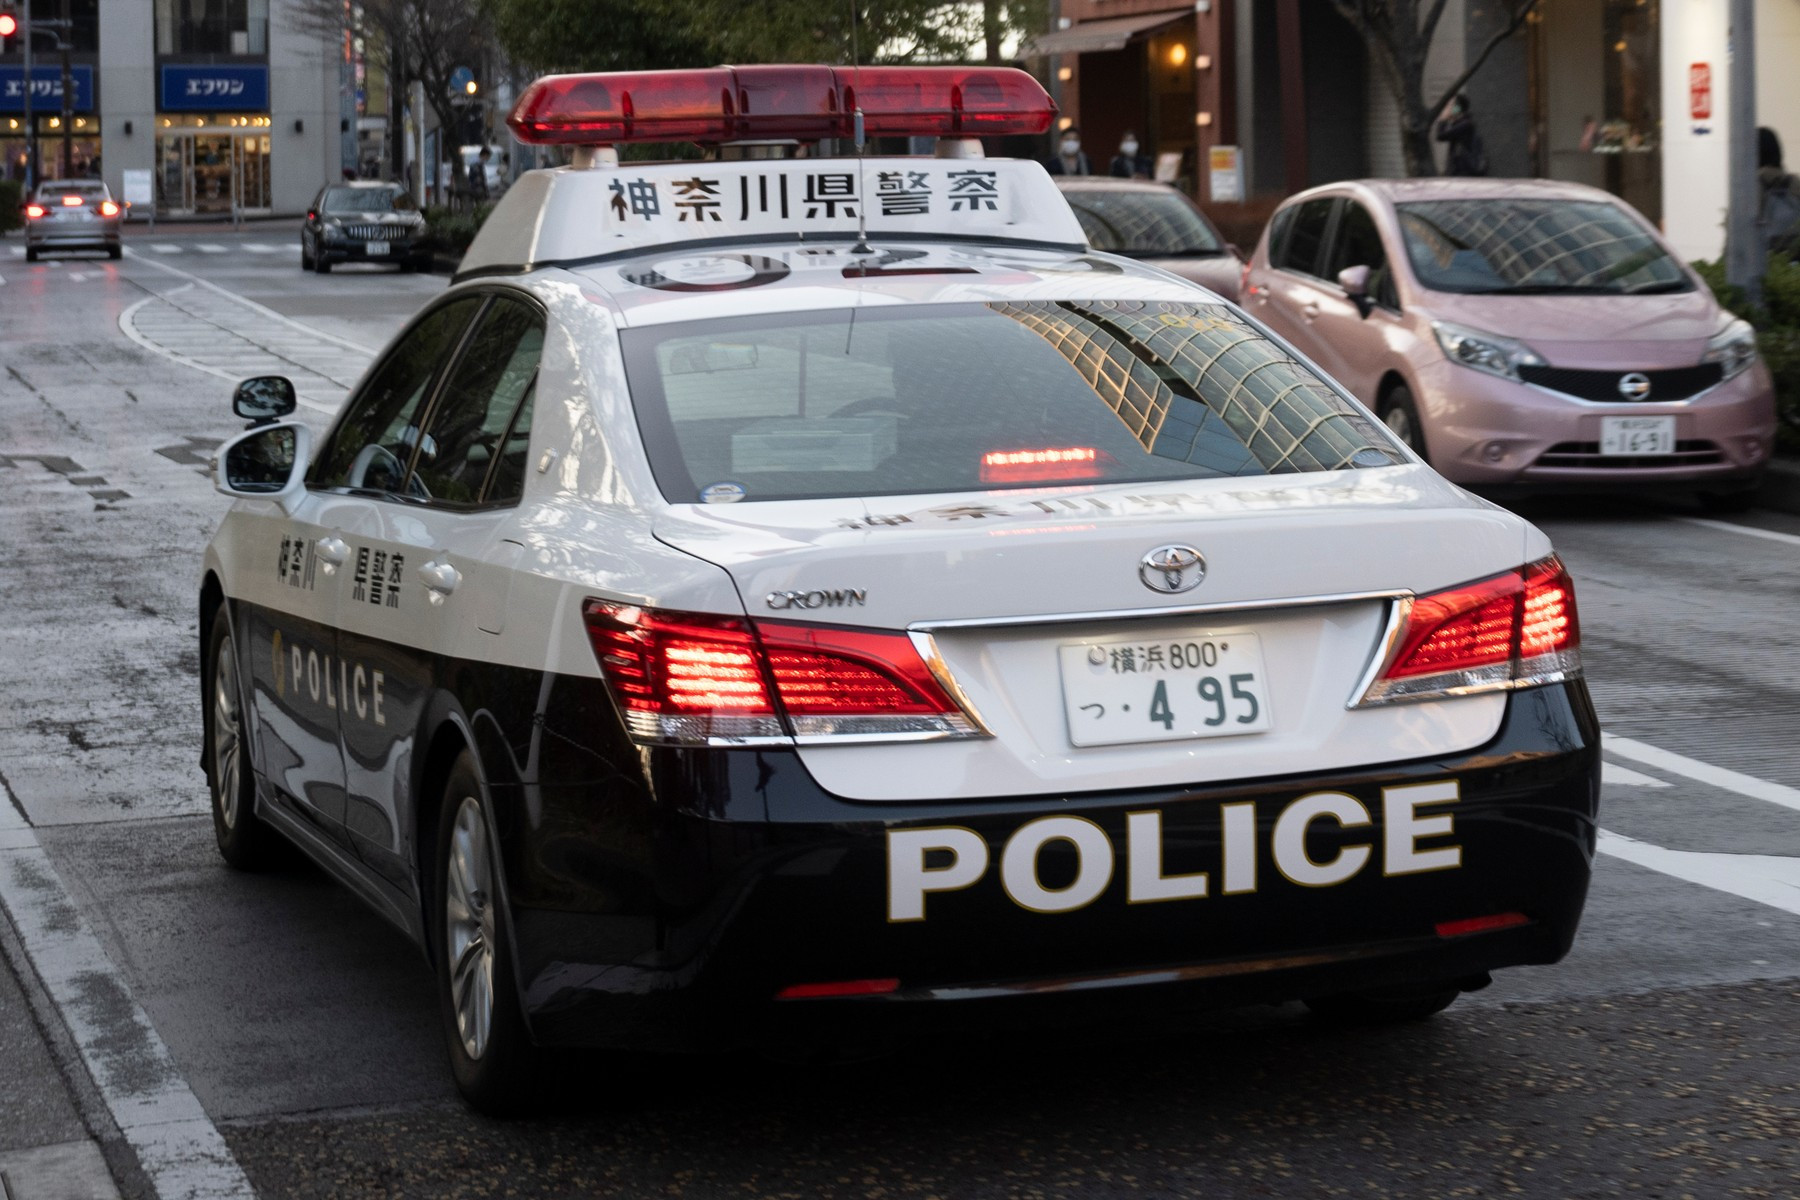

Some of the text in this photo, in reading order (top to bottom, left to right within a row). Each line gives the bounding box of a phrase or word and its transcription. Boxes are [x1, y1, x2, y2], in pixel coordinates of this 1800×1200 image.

[185, 79, 245, 96] エフワン
[608, 169, 999, 222] 神奈川県警察
[766, 588, 868, 611] CROWN
[290, 644, 387, 727] POLICE
[885, 778, 1464, 924] POLICE
